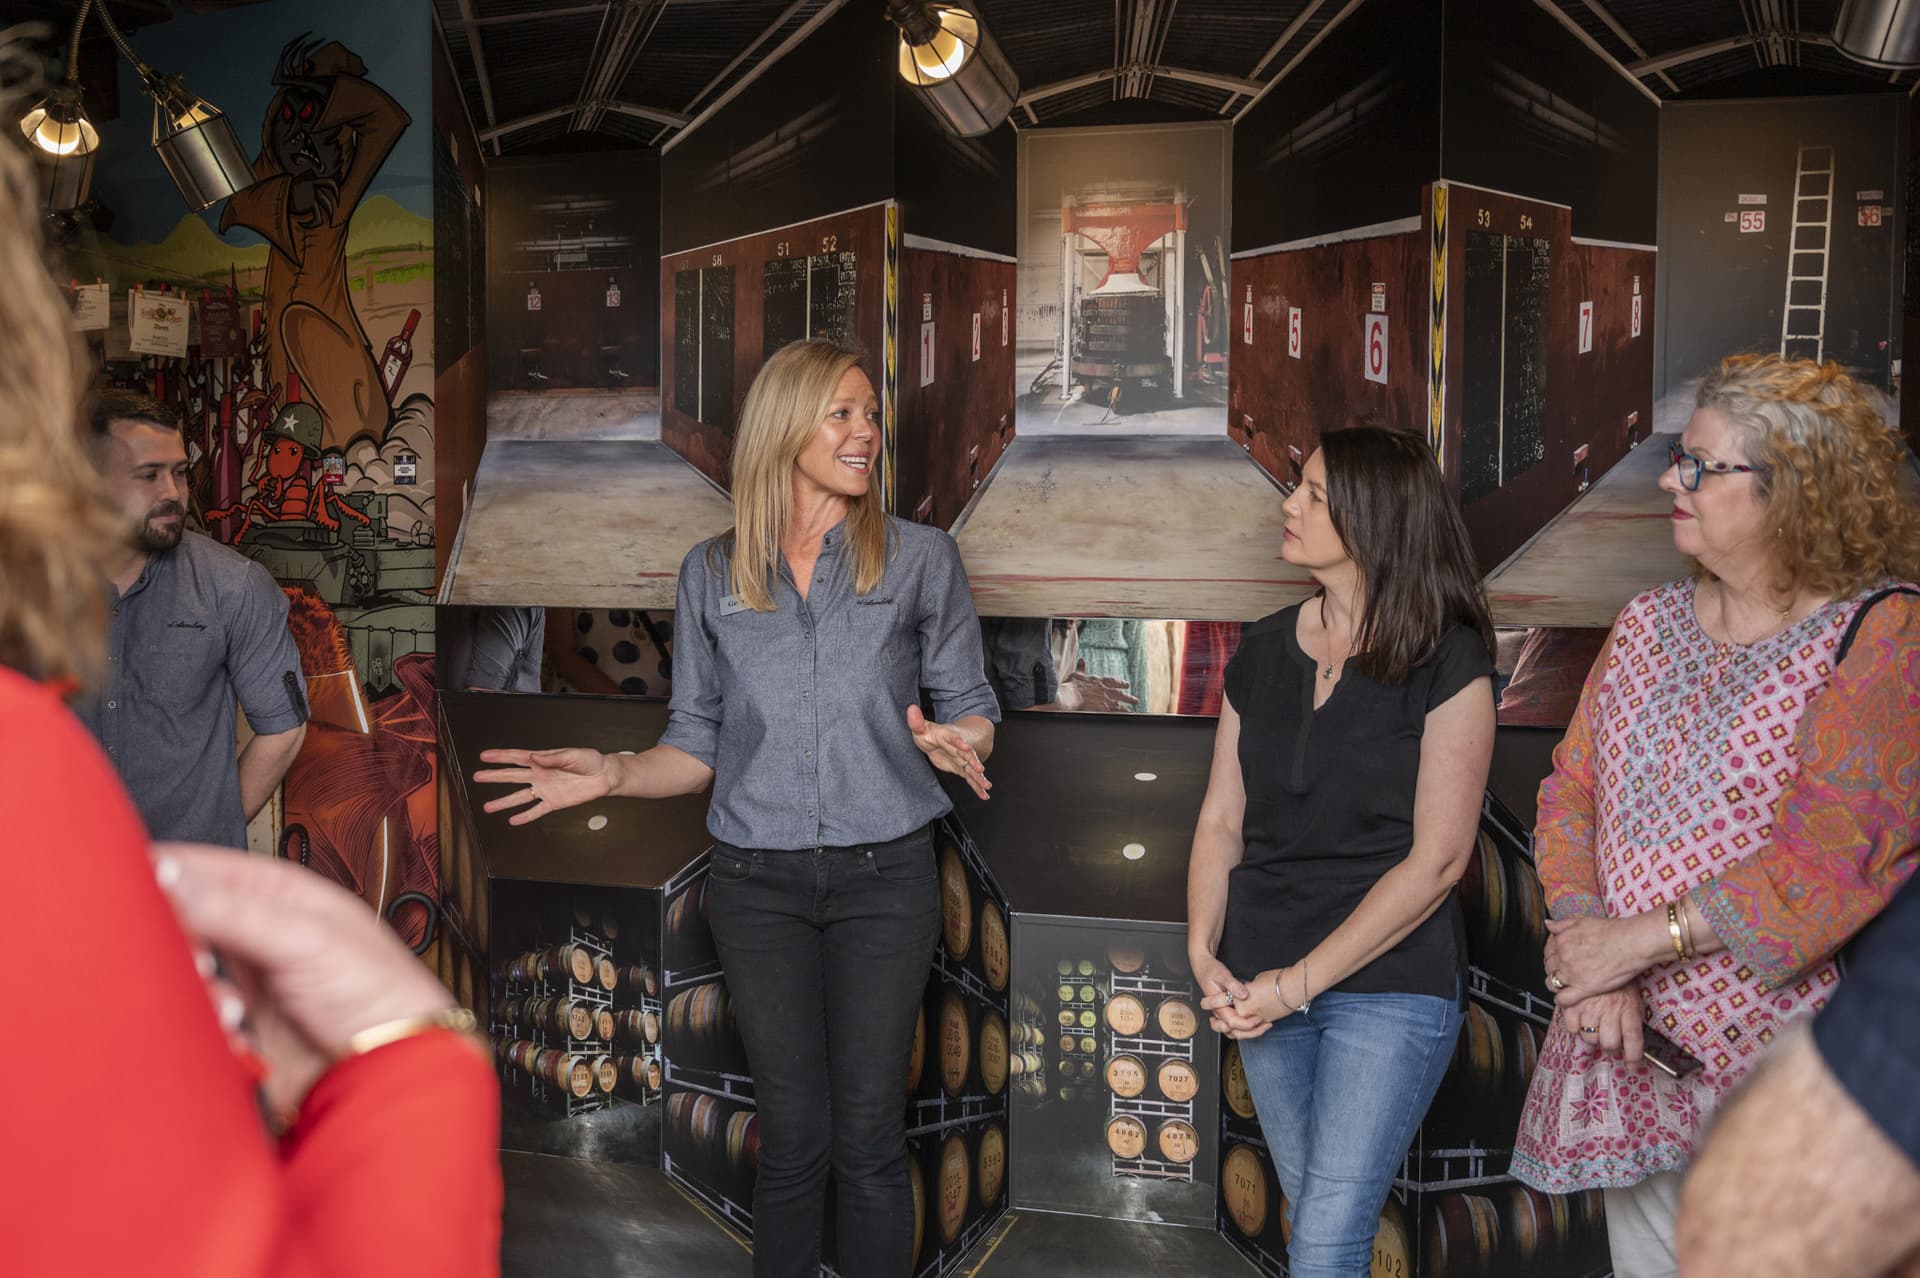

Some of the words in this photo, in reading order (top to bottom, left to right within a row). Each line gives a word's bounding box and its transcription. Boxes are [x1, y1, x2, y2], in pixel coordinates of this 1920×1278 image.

[1477, 208, 1491, 229] 53
[1519, 214, 1534, 231] 54
[1741, 212, 1764, 231] 55
[777, 242, 790, 257] 51
[823, 236, 838, 253] 52
[528, 295, 542, 309] 12
[607, 291, 621, 307] 13
[1291, 312, 1300, 353] 5
[1583, 308, 1591, 350] 7
[1369, 320, 1383, 376] 6
[1234, 1172, 1257, 1195] 7071
